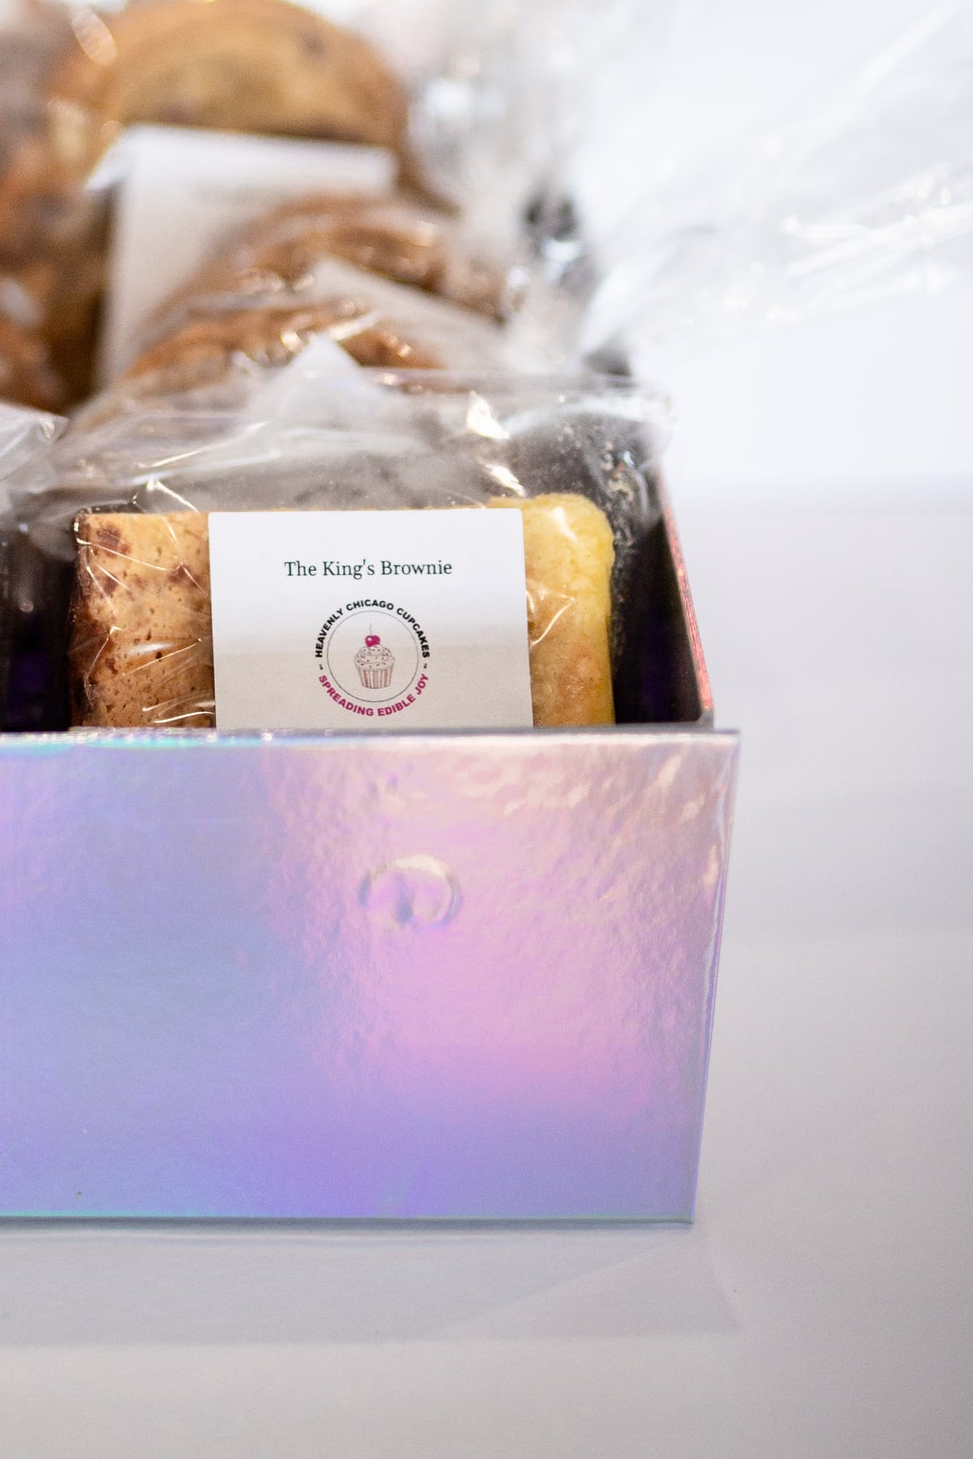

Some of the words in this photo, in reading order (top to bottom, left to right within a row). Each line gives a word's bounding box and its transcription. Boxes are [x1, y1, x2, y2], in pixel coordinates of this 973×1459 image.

[283, 560, 318, 577] The
[322, 558, 375, 580] King's
[380, 559, 453, 576] Brownie
[315, 608, 344, 658] HEAVENLY
[346, 599, 394, 611] CHICAGO
[396, 607, 431, 659] CUPCAKES
[318, 674, 374, 717] SPREADING
[377, 693, 416, 717] EDIBLE
[414, 673, 429, 695] JOY
